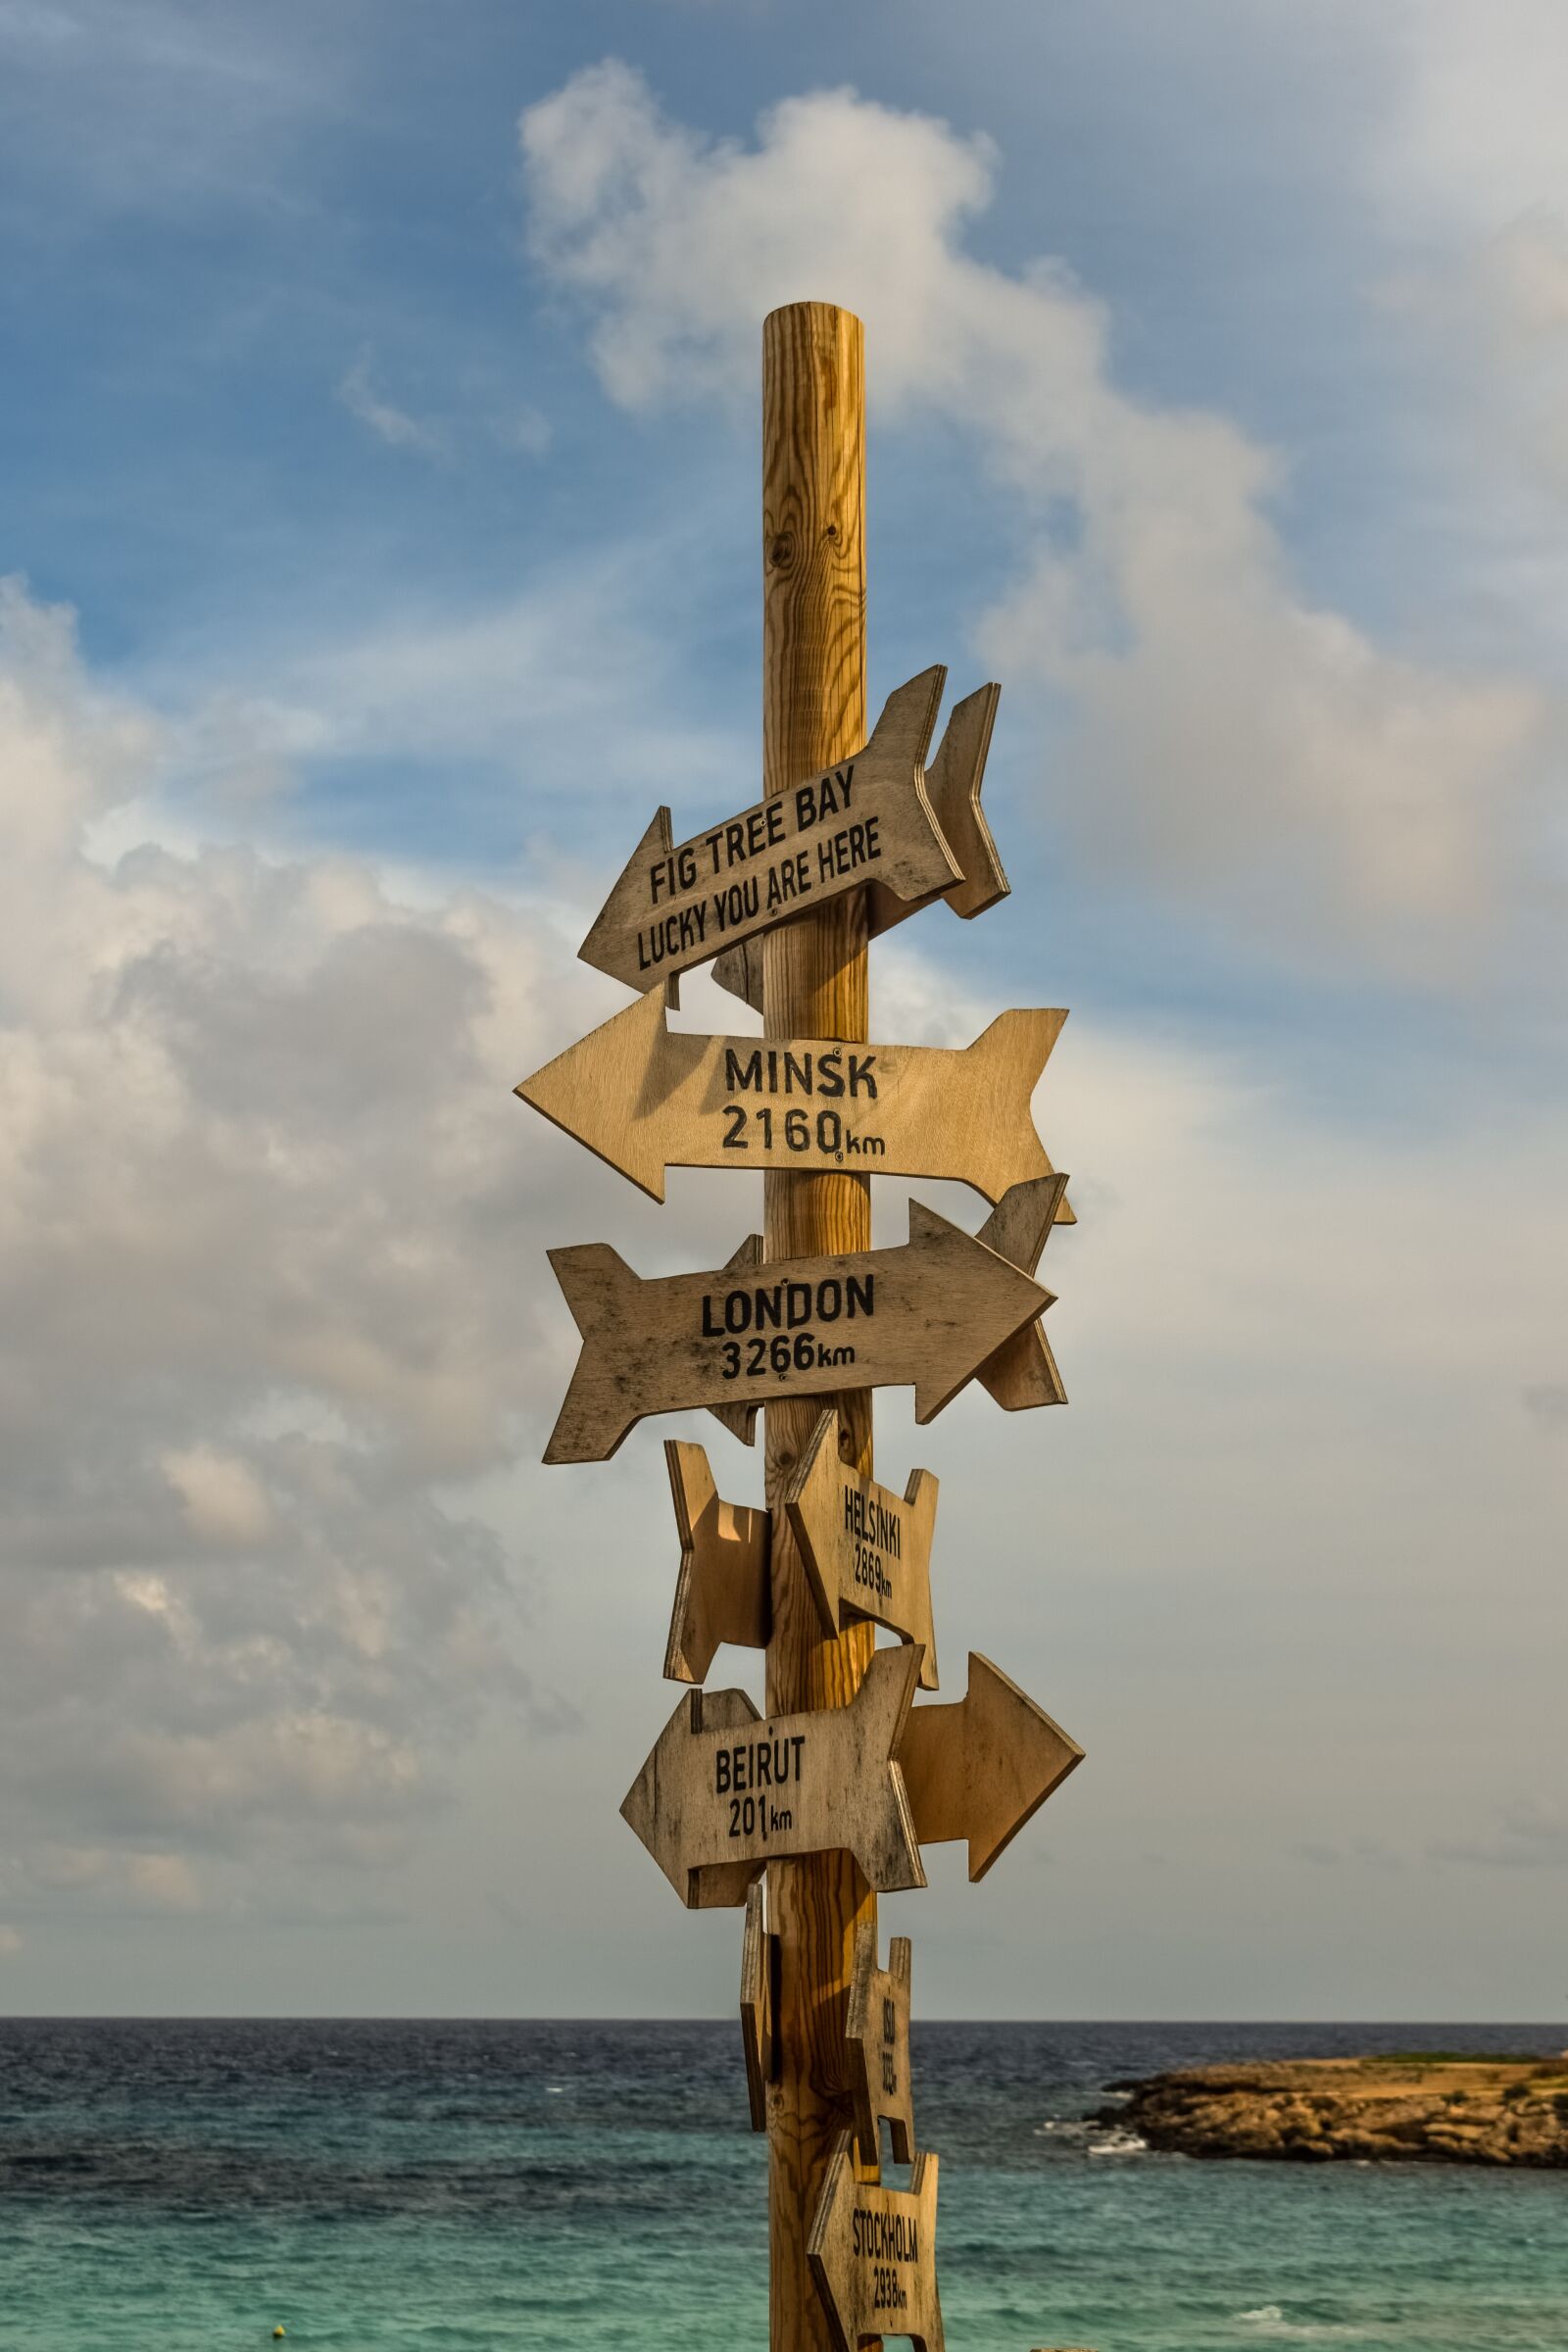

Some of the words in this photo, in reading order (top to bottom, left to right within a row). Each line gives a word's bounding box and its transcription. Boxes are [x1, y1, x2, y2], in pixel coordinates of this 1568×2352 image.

[651, 848, 696, 904] FIG
[706, 801, 785, 874] TREE
[796, 765, 855, 832] BAY
[637, 901, 706, 970] LUCKY
[713, 875, 760, 932] YOU
[767, 850, 811, 908] ARE
[817, 816, 881, 883] HERE
[724, 1049, 878, 1099] MINSK
[702, 1275, 874, 1337] LONDON
[844, 1485, 901, 1560] HELSINKI
[715, 1736, 806, 1793] BEIRUT
[853, 2208, 918, 2263] STOCKHOLM
